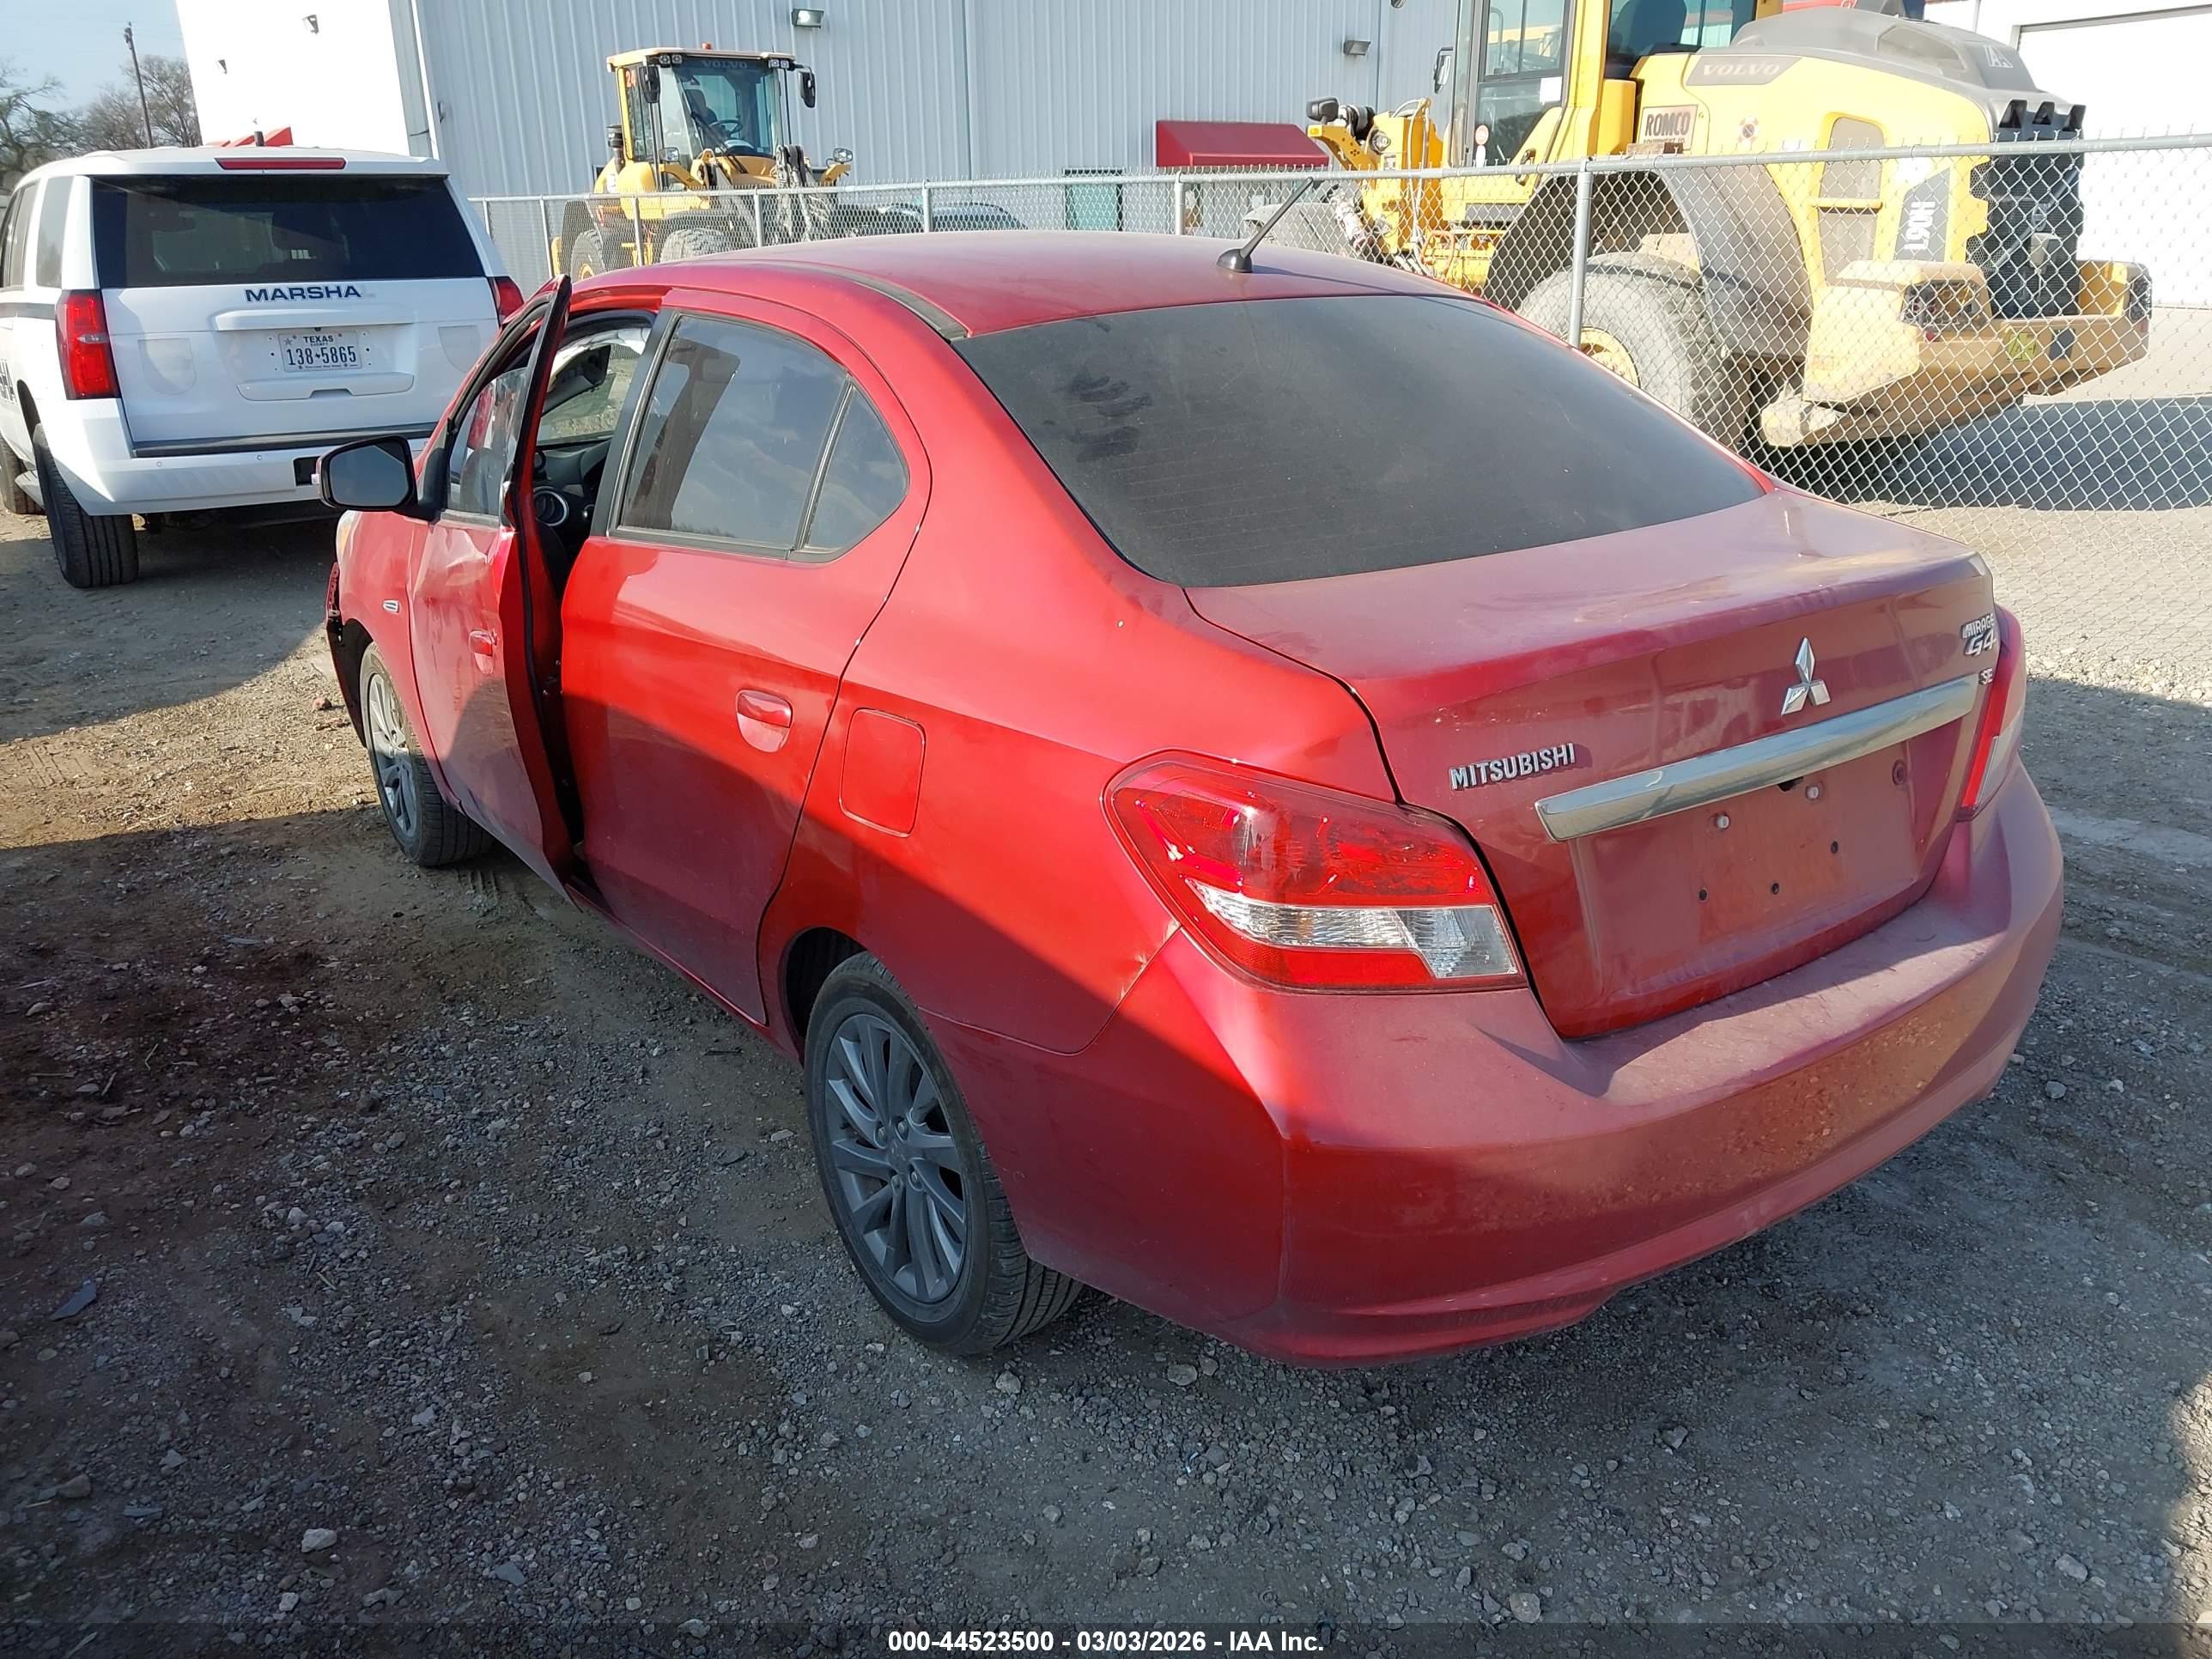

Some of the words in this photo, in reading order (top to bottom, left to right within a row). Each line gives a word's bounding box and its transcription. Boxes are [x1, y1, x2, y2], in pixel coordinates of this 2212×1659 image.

[702, 60, 748, 70] VOLVO
[1703, 63, 1780, 76] VOLVO
[1644, 112, 1691, 137] ROMCO
[303, 335, 334, 343] TEXAS
[1960, 612, 1995, 639] MIRAGE
[1964, 628, 1996, 657] G4
[1978, 667, 1994, 686] SE
[1449, 742, 1577, 790] MITSUBISHI
